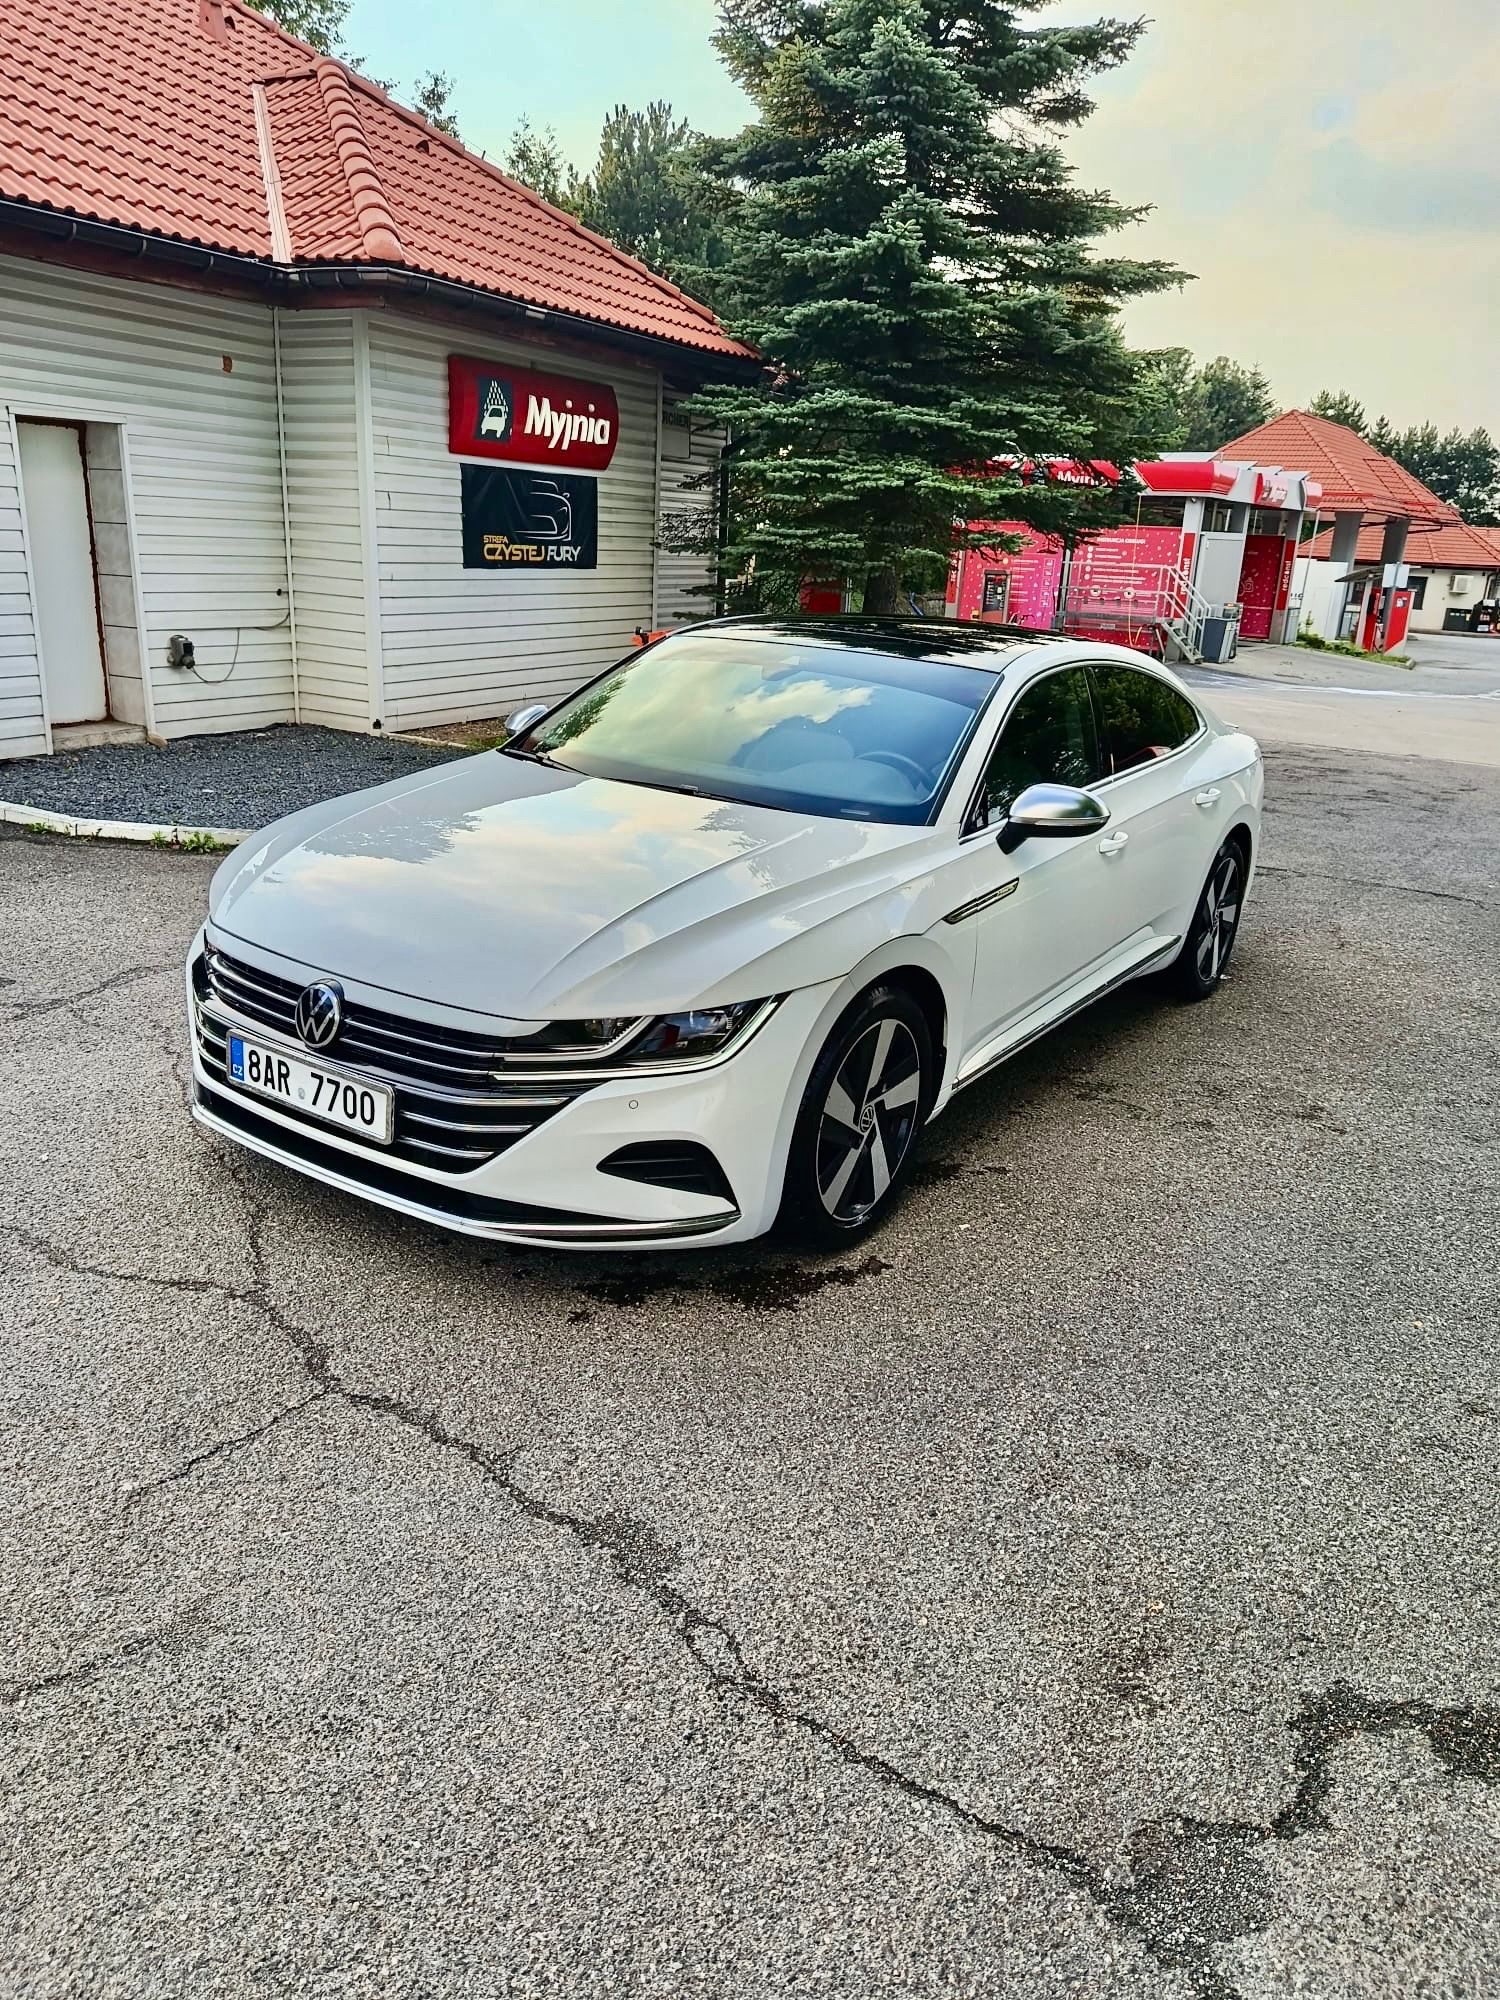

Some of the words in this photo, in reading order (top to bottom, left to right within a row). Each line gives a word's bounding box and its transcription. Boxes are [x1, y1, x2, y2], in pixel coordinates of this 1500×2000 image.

[524, 394, 611, 450] Myjnia
[483, 535, 508, 544] STREFA
[483, 543, 545, 561] CZYSTEJ
[547, 545, 581, 562] FURY
[232, 1063, 244, 1077] CZ
[248, 1050, 290, 1096] 8AR
[310, 1072, 375, 1126] 7700
